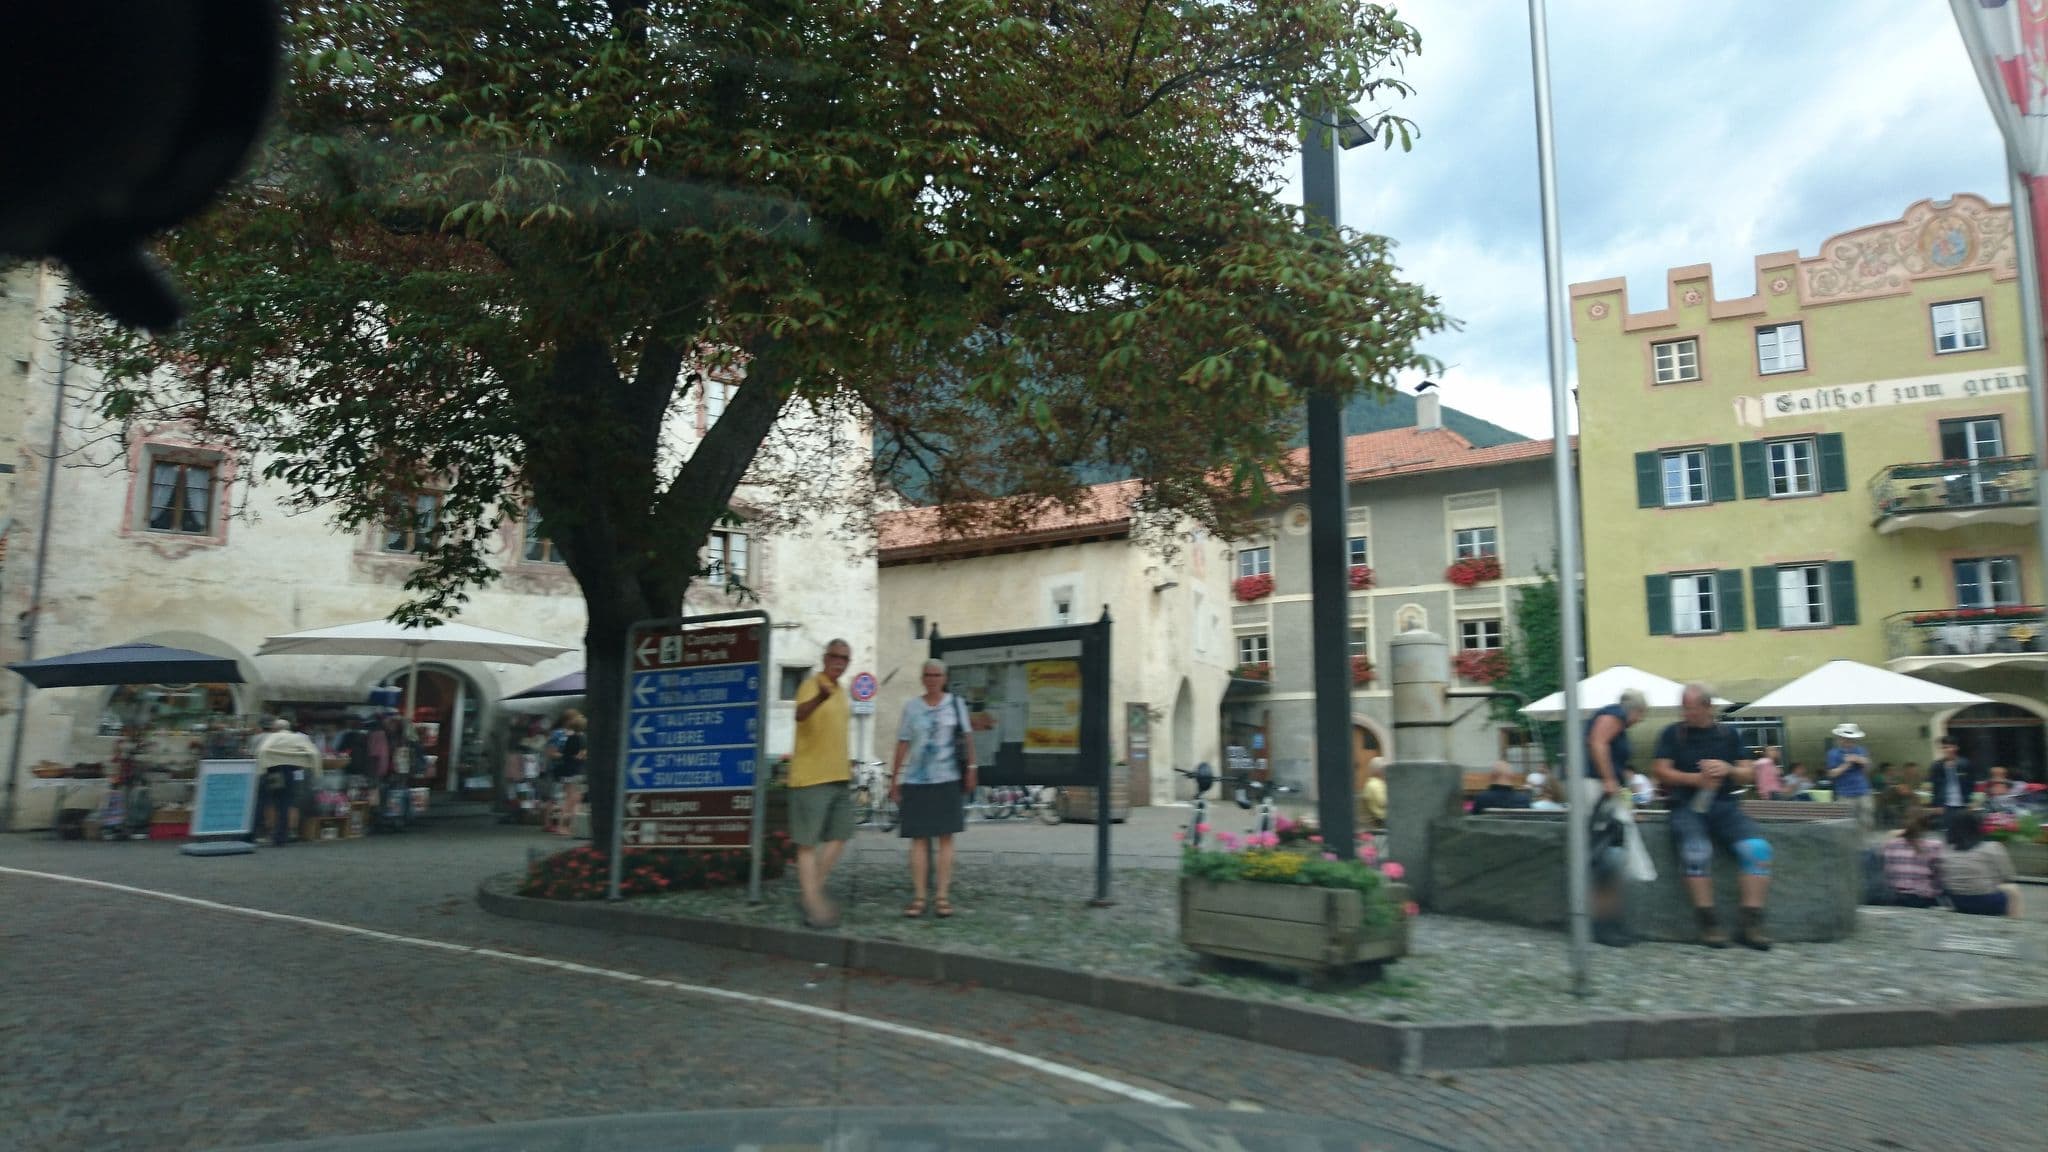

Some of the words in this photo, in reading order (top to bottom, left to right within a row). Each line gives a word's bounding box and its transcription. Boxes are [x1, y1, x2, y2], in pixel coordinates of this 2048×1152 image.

[1893, 382, 1943, 403] zum
[656, 710, 725, 727] TAUFERS
[655, 730, 705, 745] TUBRE
[655, 752, 721, 768] SCHWEIZ
